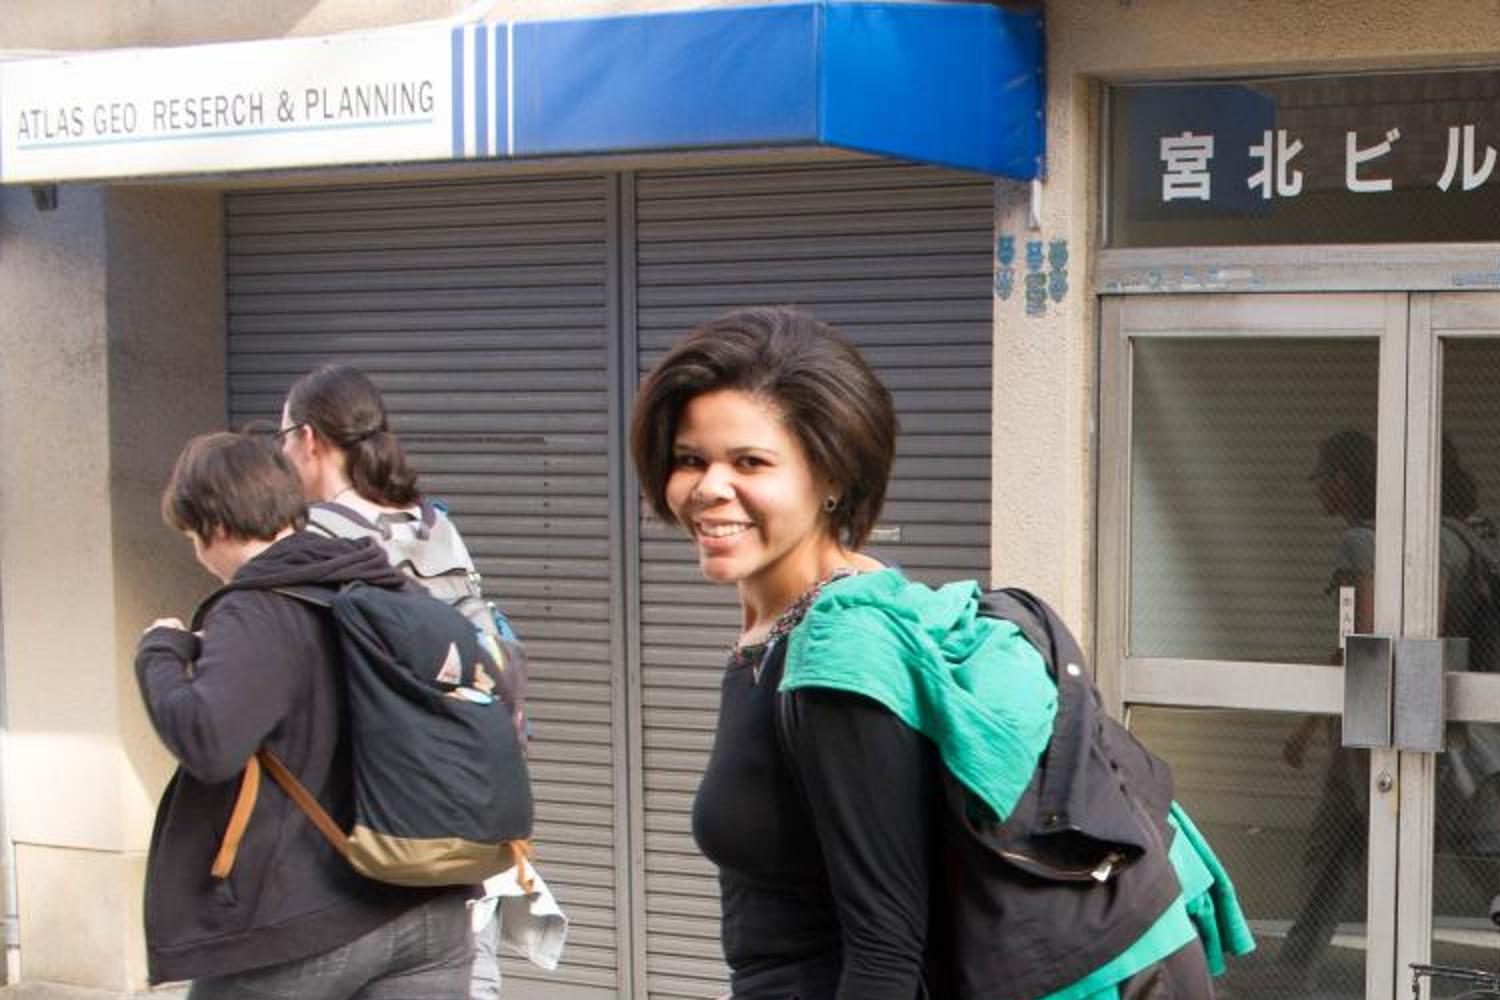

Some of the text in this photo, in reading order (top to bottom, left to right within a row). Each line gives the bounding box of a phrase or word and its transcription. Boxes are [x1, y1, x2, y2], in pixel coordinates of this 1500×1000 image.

[18, 80, 434, 139] ATLAS GEO RESERCH & PLANNING
[1159, 125, 1497, 202] 宮北ビル
